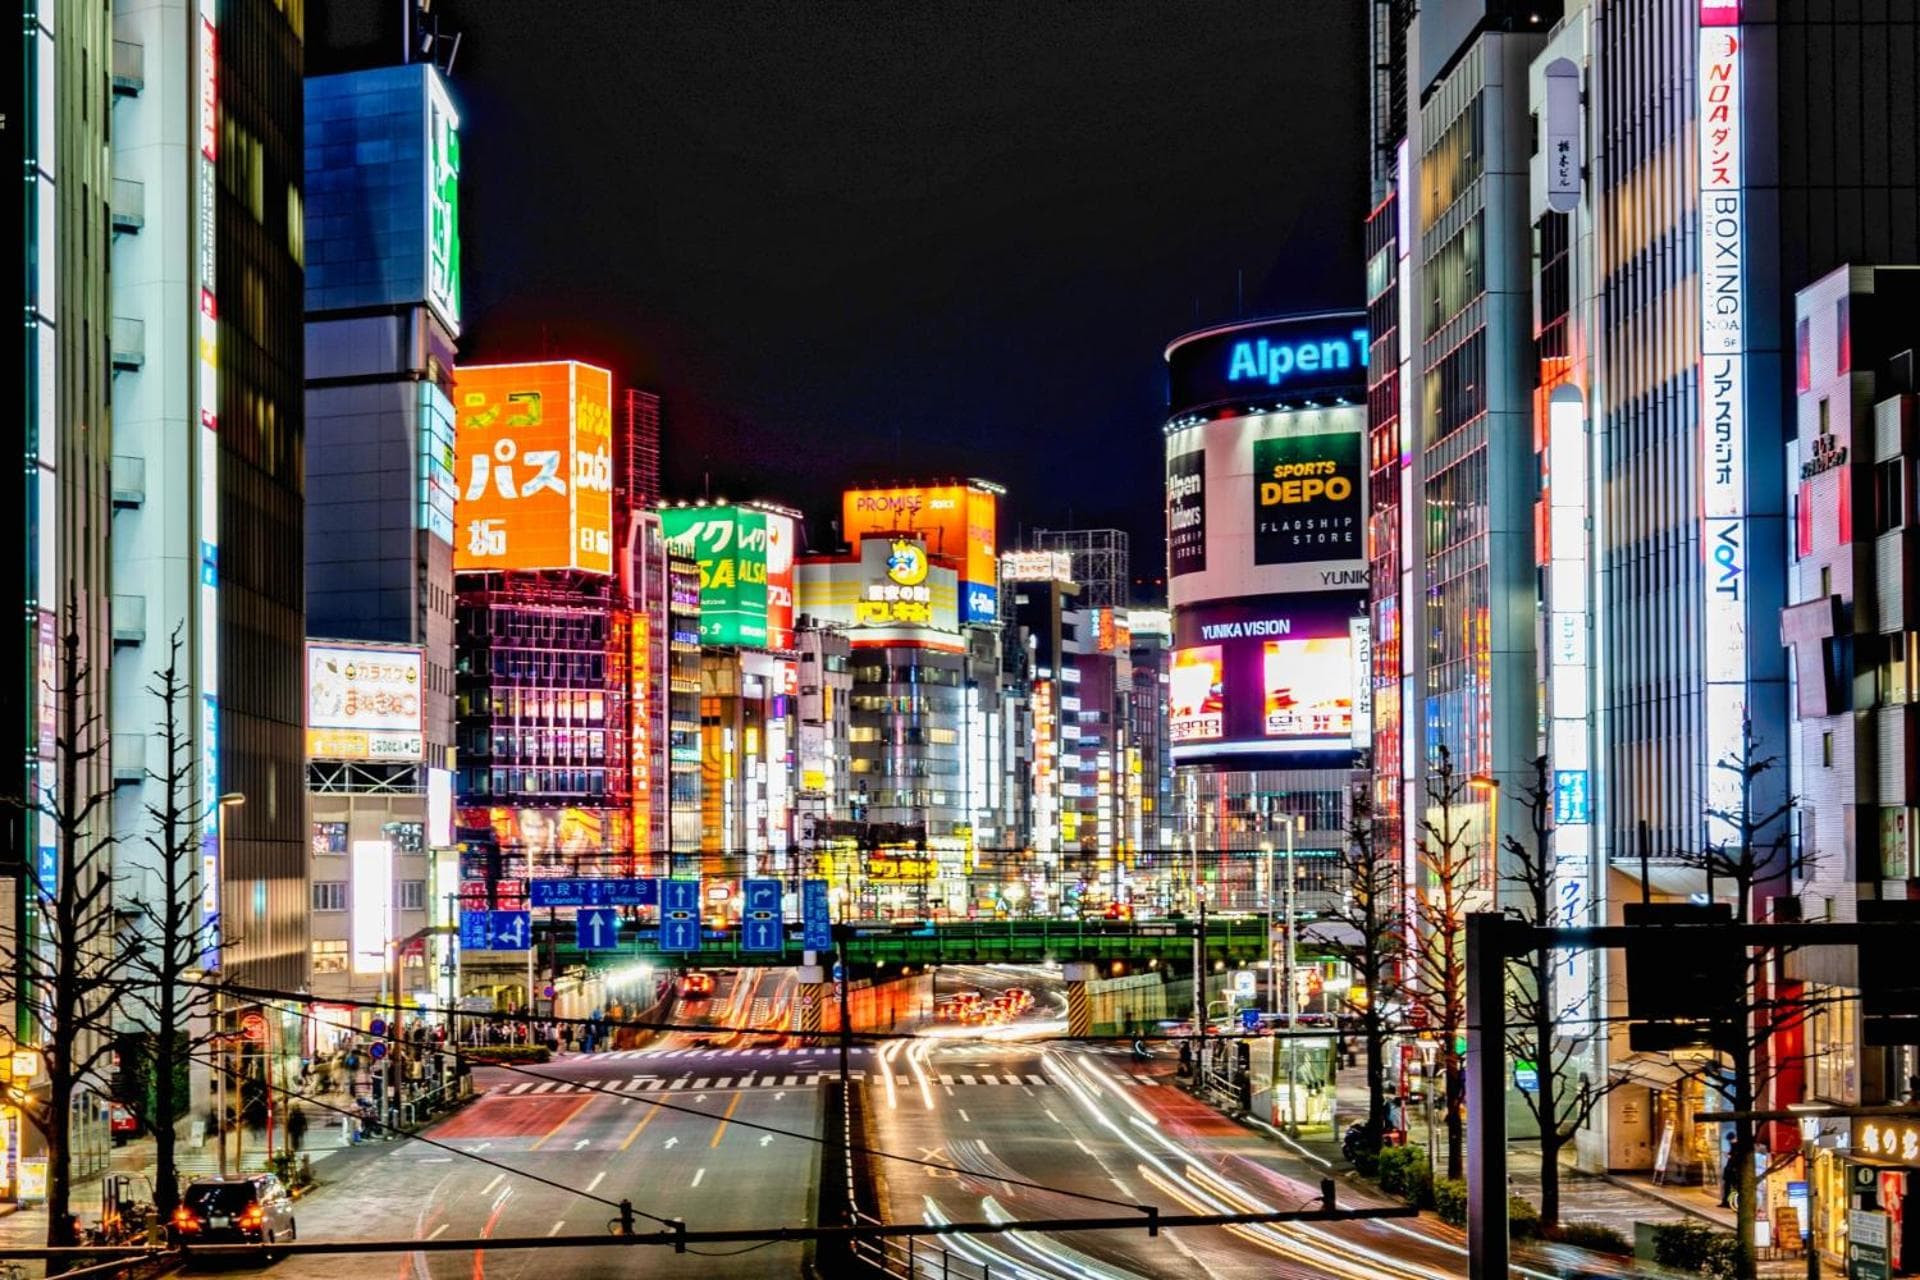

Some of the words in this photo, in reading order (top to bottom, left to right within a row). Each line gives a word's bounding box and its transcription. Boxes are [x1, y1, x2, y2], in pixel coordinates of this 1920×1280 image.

[1715, 197, 1739, 314] BOXING
[1228, 338, 1349, 384] Alpen
[1273, 461, 1336, 478] SPORTS
[1260, 476, 1352, 506] DEPO
[857, 495, 922, 512] PROMISE
[1260, 516, 1353, 533] FLAGSHIP
[1292, 531, 1353, 545] STORE
[1202, 620, 1242, 640] YUNIKA
[1244, 619, 1291, 637] VISION
[358, 662, 404, 681] カラオケ
[345, 688, 417, 717] まねきねこ
